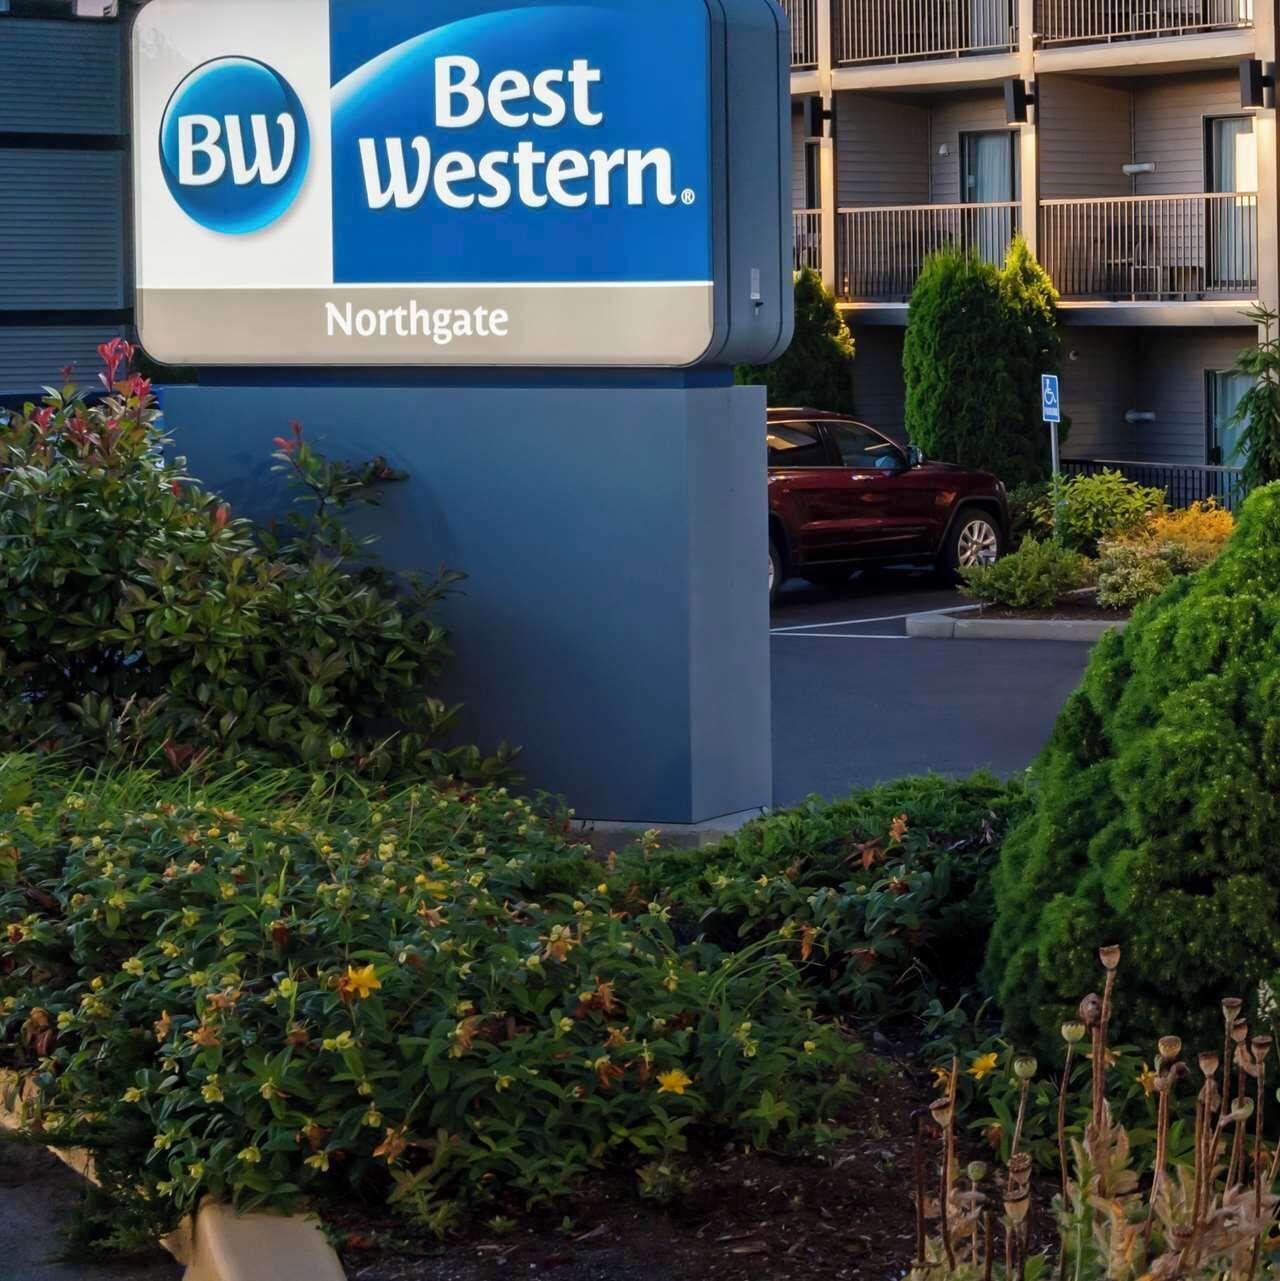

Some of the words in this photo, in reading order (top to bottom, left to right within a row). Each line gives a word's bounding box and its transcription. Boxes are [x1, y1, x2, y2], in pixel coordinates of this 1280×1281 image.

[434, 55, 603, 128] Best
[177, 112, 297, 187] BW
[325, 300, 509, 344] Northgate
